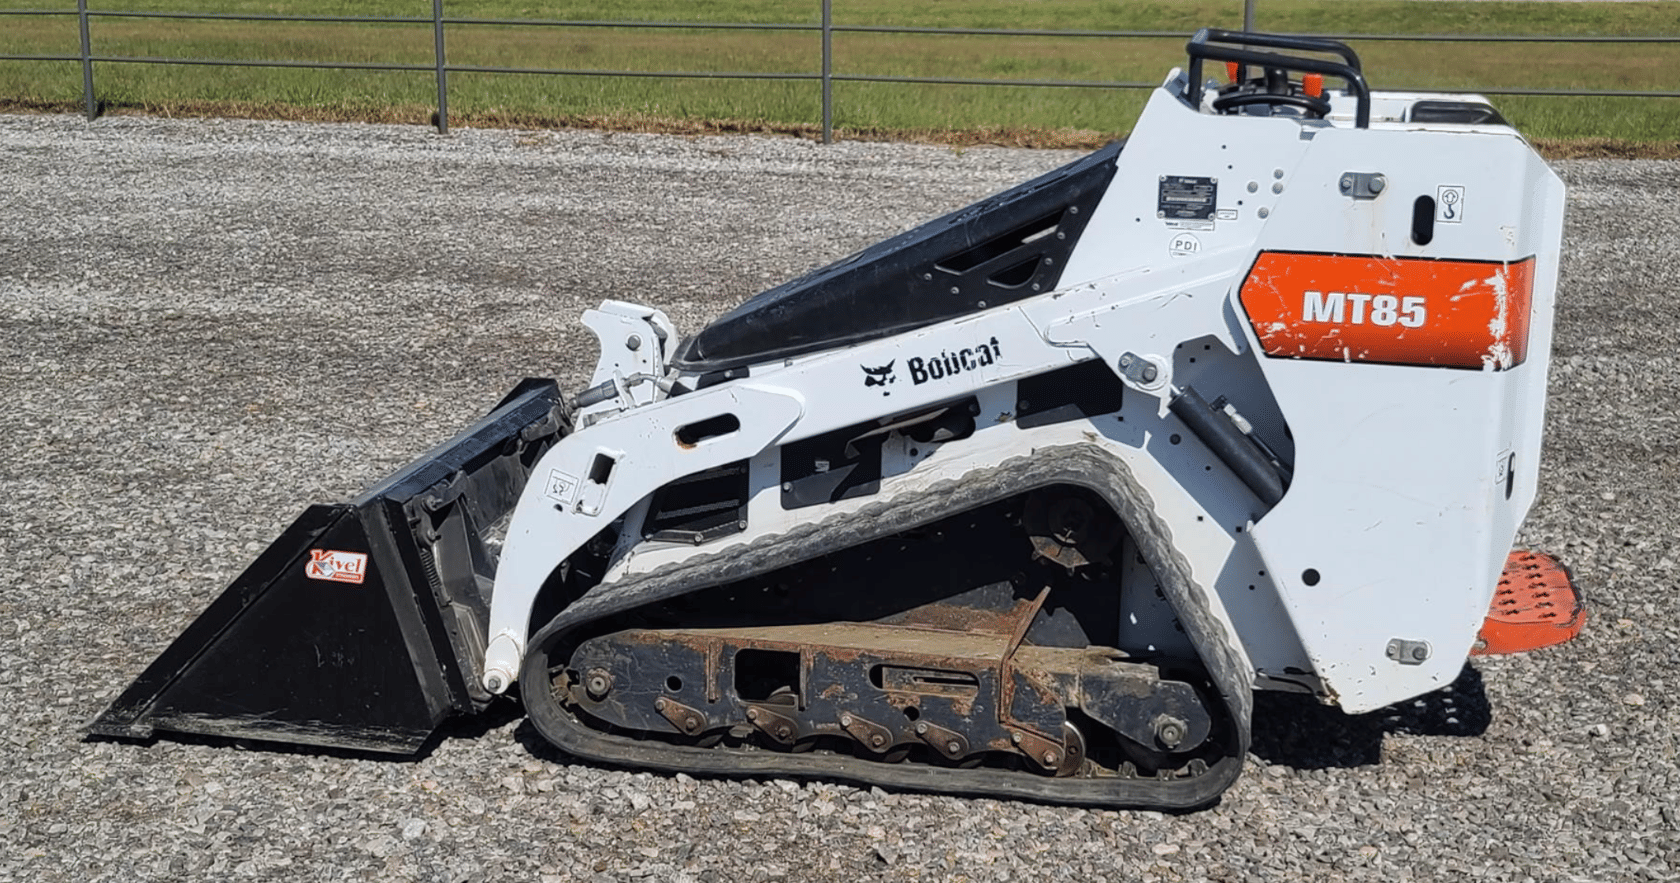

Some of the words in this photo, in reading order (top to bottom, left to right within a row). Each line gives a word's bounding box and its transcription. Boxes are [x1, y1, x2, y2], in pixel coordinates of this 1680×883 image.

[1175, 240, 1198, 251] PDI
[1302, 291, 1426, 328] MT85
[907, 336, 1002, 386] Bobcat
[311, 551, 362, 574] Kivel
